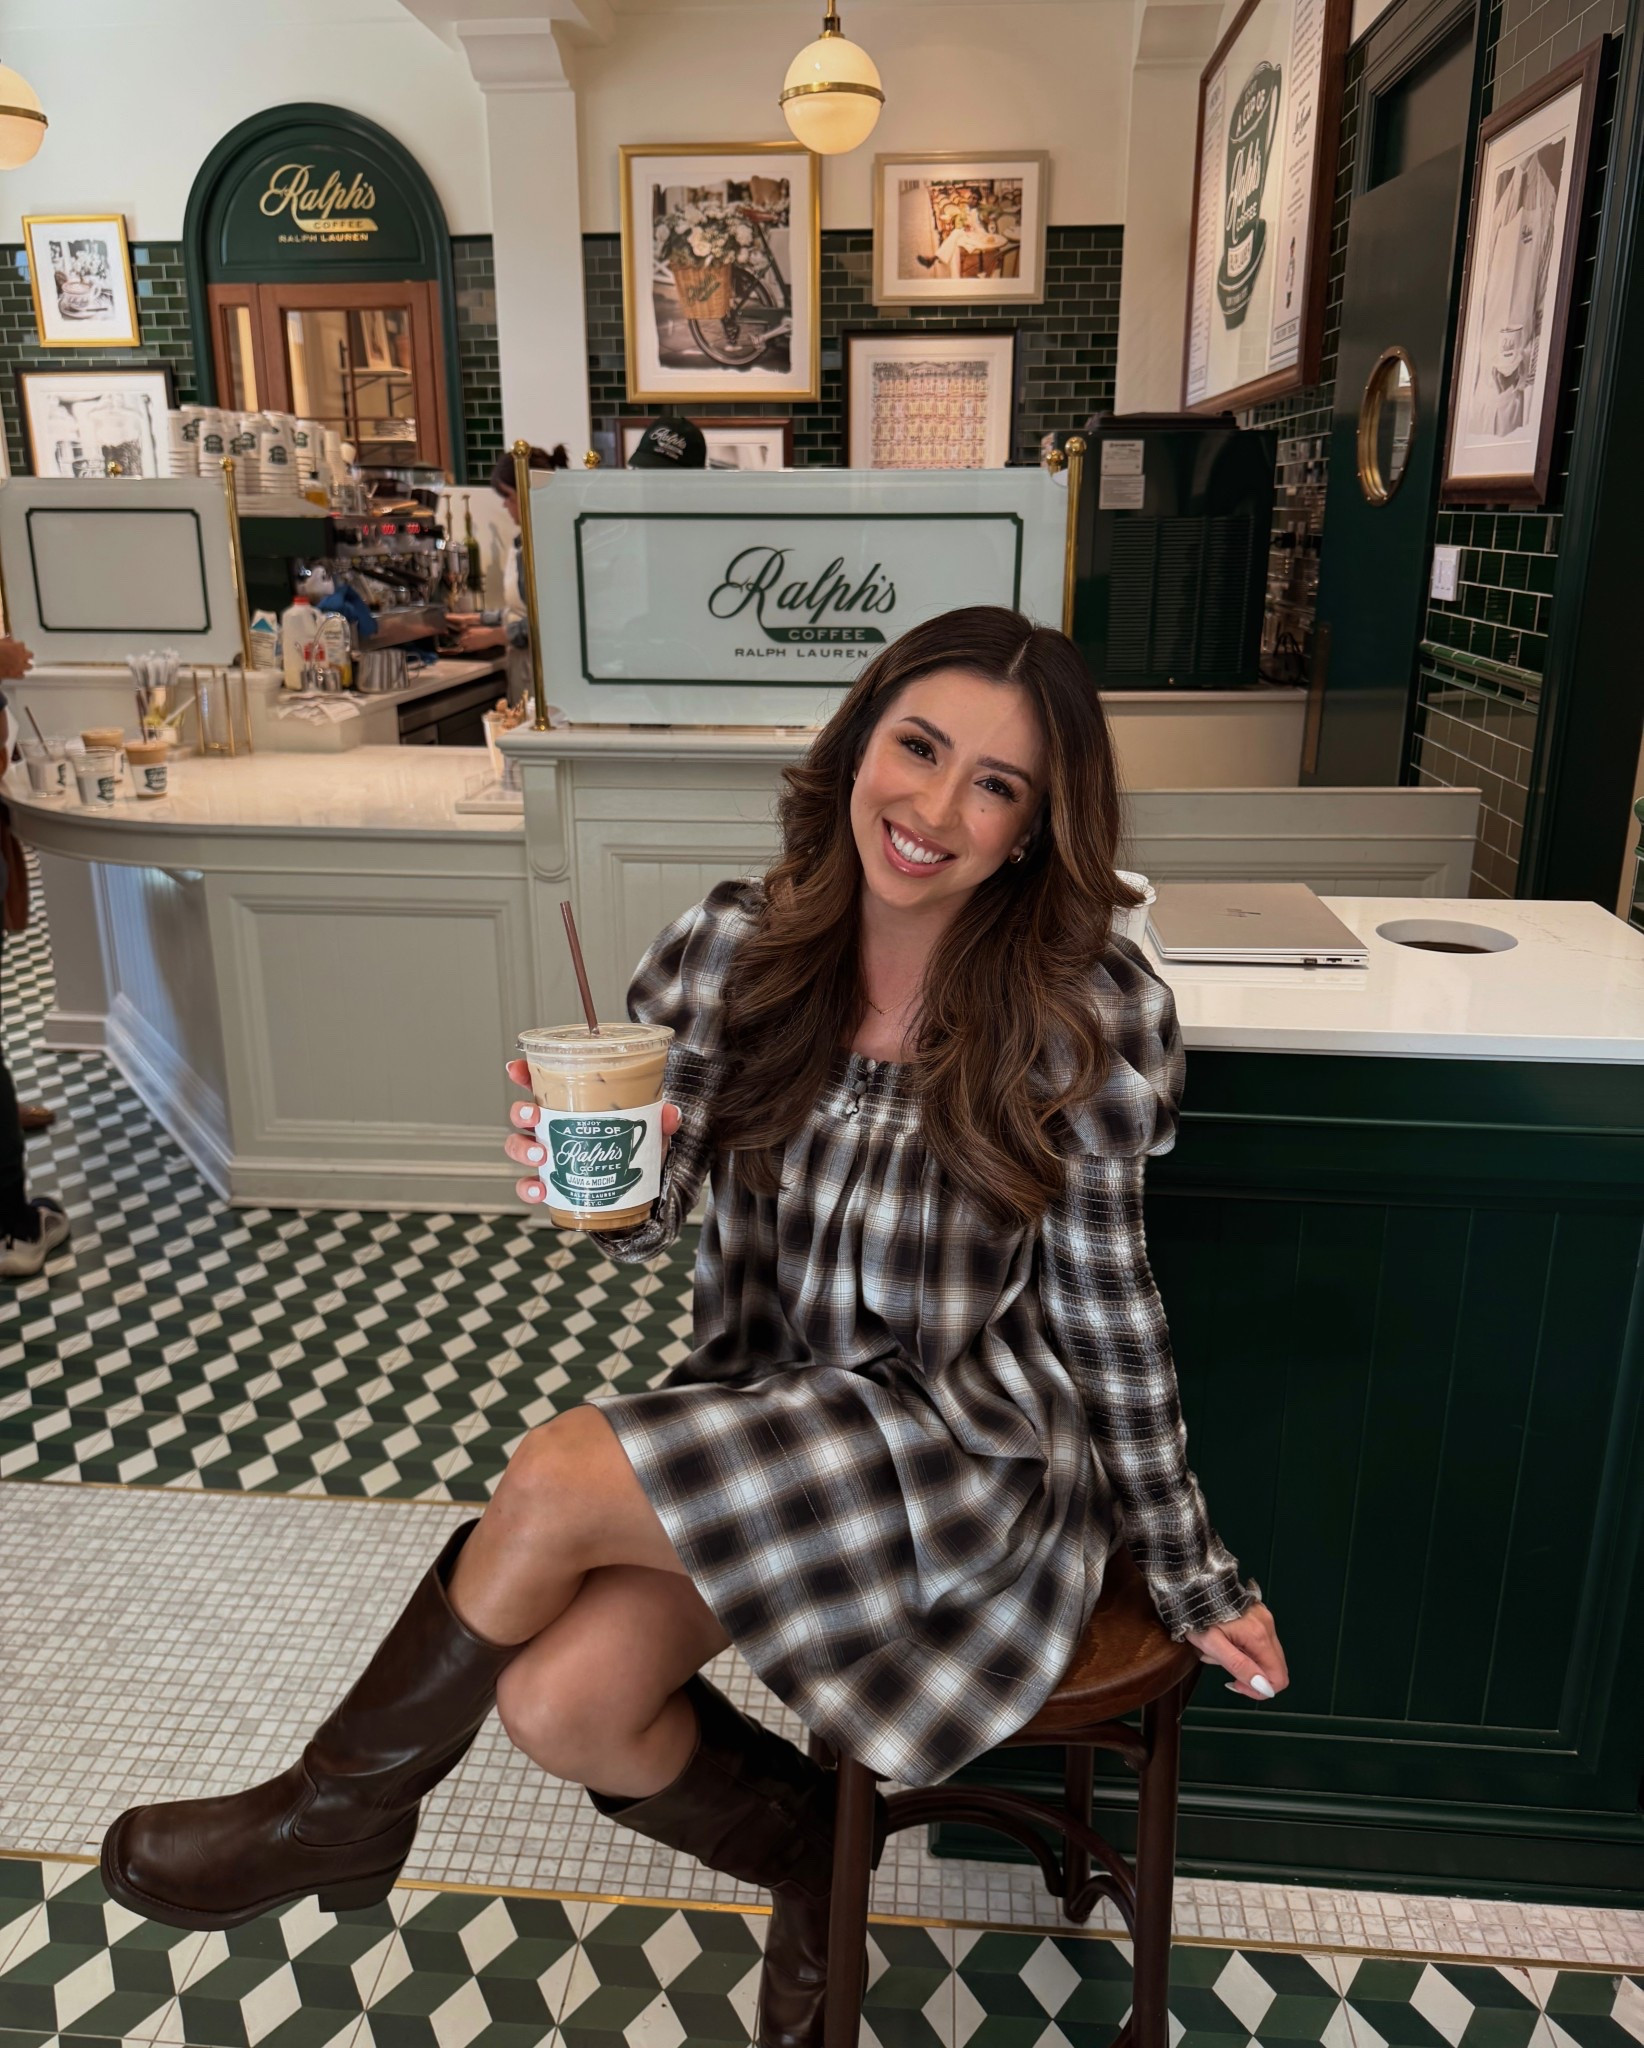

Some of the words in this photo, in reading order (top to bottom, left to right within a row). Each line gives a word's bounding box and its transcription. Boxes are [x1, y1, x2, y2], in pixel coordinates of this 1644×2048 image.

[259, 163, 376, 220] Ralph's
[313, 221, 363, 229] COFFEE
[278, 234, 318, 243] RALPH
[320, 233, 369, 242] LAUREN
[708, 546, 896, 625] Ralph's
[787, 629, 866, 641] COFFEE
[734, 648, 786, 658] RALPH
[796, 648, 869, 659] LAUREN
[604, 1126, 621, 1135] OF
[556, 1139, 623, 1173] Ralph's
[580, 1163, 622, 1172] COFFEE
[568, 1175, 585, 1186] JAVA
[591, 1175, 615, 1187] MOCHA
[591, 1191, 616, 1199] LAUREN
